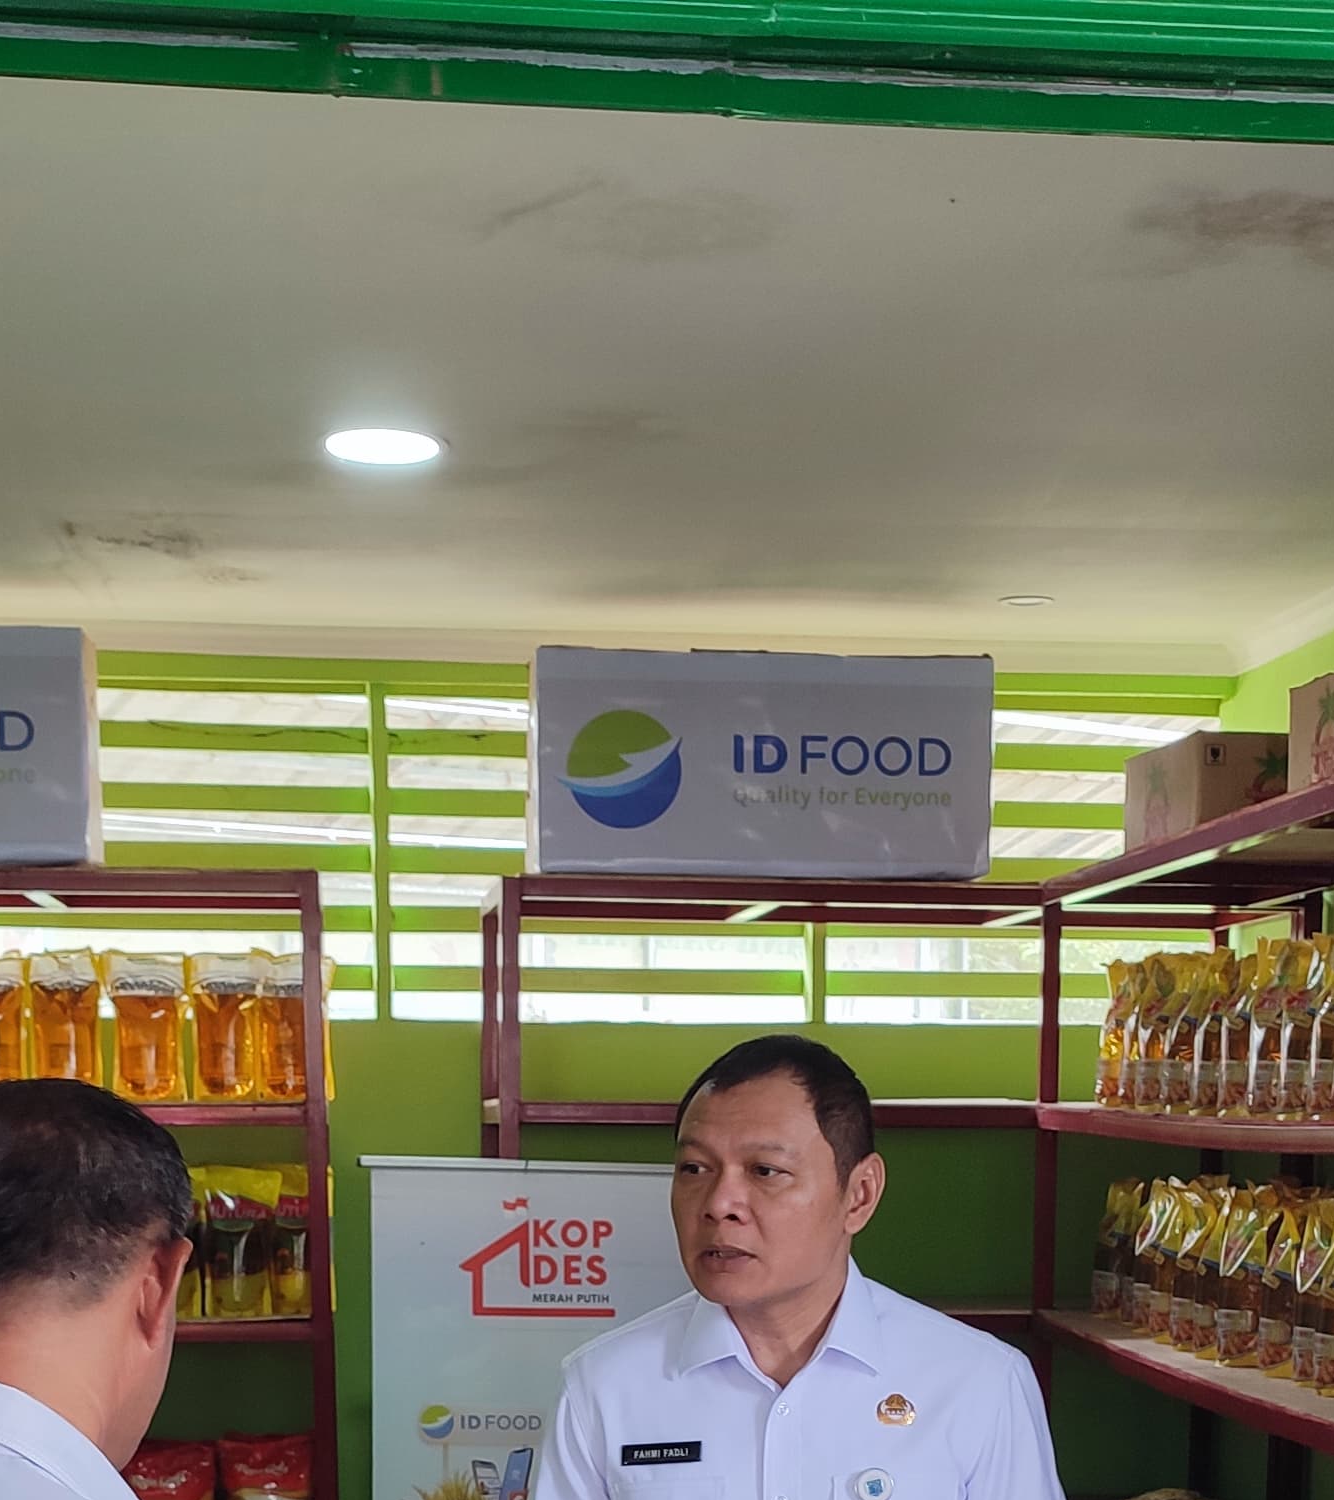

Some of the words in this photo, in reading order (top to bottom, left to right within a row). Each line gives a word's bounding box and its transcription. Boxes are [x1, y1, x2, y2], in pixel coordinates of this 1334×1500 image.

[733, 733, 788, 774] ID
[800, 735, 952, 777] FOOD
[733, 785, 812, 811] Quality
[819, 785, 848, 806] for
[854, 787, 952, 812] Everyone
[532, 1219, 614, 1249] KOP
[533, 1254, 607, 1286] DES
[532, 1293, 573, 1304] MERAH
[576, 1293, 610, 1304] PUTIH
[460, 1414, 481, 1430] ID
[485, 1414, 542, 1431] FOOD
[633, 1449, 661, 1459] FAHMI
[663, 1447, 689, 1458] FADLI
